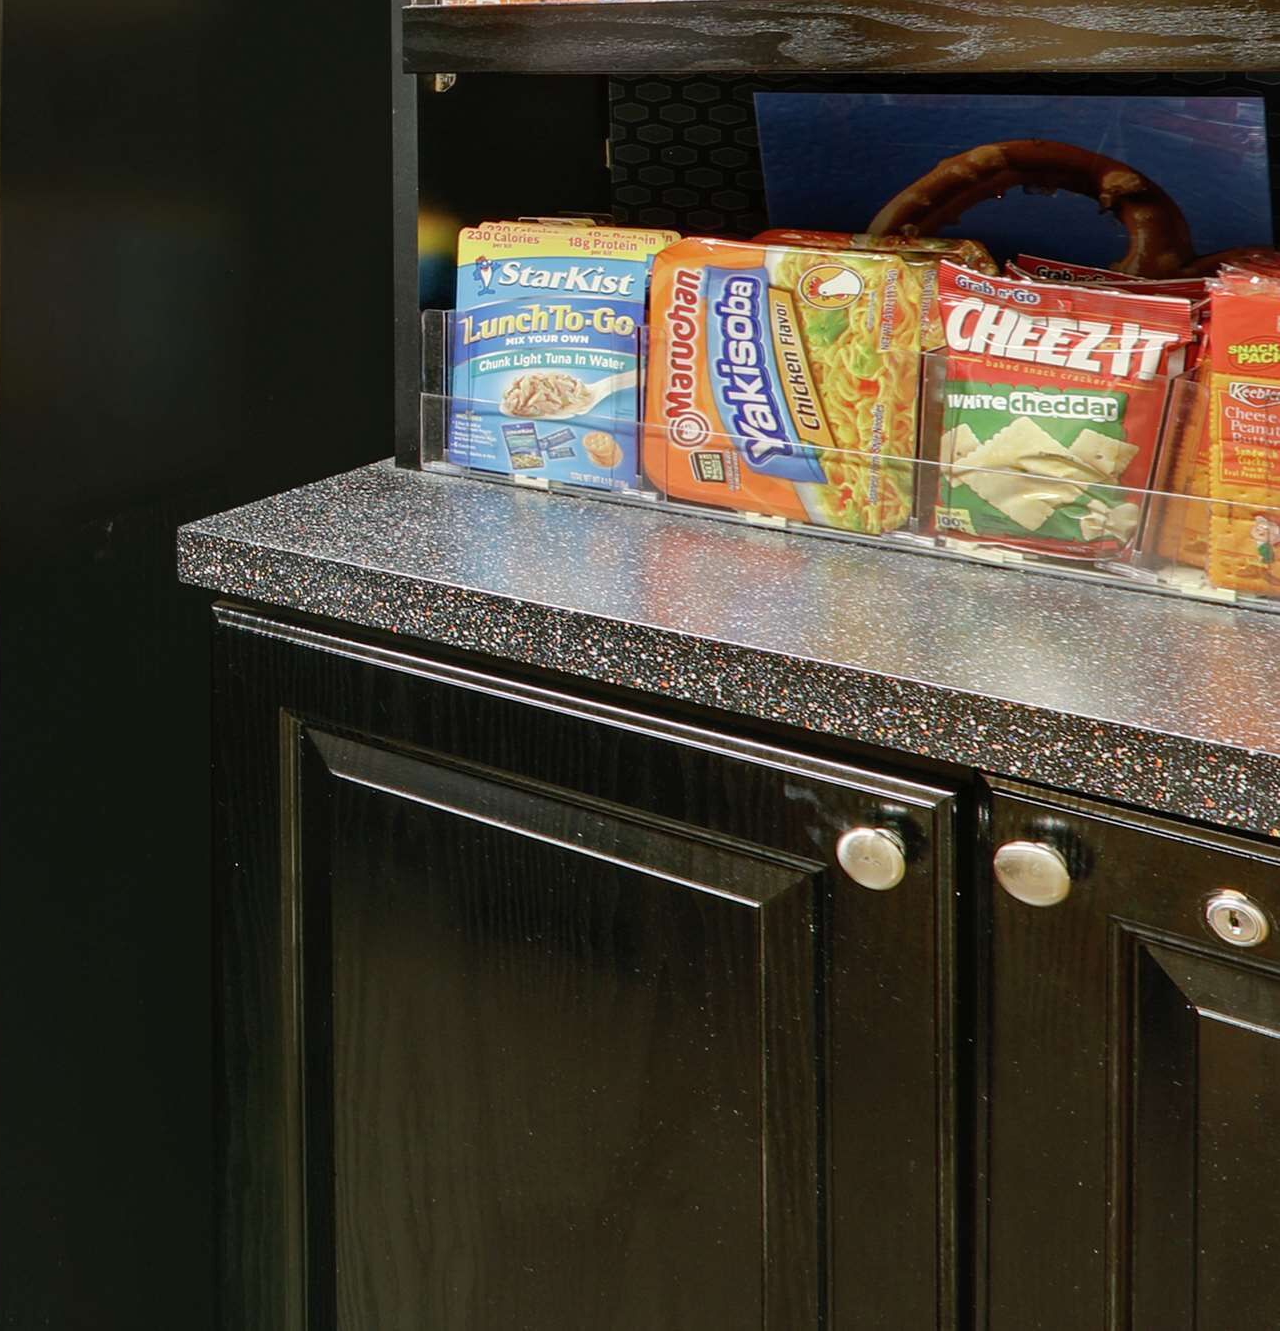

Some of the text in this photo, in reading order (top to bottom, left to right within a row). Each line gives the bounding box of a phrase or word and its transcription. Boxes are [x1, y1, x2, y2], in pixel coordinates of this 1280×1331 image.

[466, 230, 540, 245] 230 Calories
[568, 236, 638, 252] 18g Protein
[497, 261, 635, 297] StarKist
[956, 275, 993, 296] Grab
[1013, 289, 1039, 305] Go
[505, 334, 589, 346] MIX YOUR OWN
[666, 269, 701, 419] Maruchan
[1228, 343, 1280, 356] SNACK
[479, 354, 511, 371] Chunk
[513, 353, 542, 367] Light
[545, 353, 572, 365] Tuna
[589, 354, 625, 370] Water
[718, 277, 788, 463] Yakisoba
[774, 301, 821, 431] Chicken Flavor
[985, 360, 1115, 388] baked snack crackers
[1011, 393, 1118, 419] cheddar
[1225, 406, 1278, 421] Cheese
